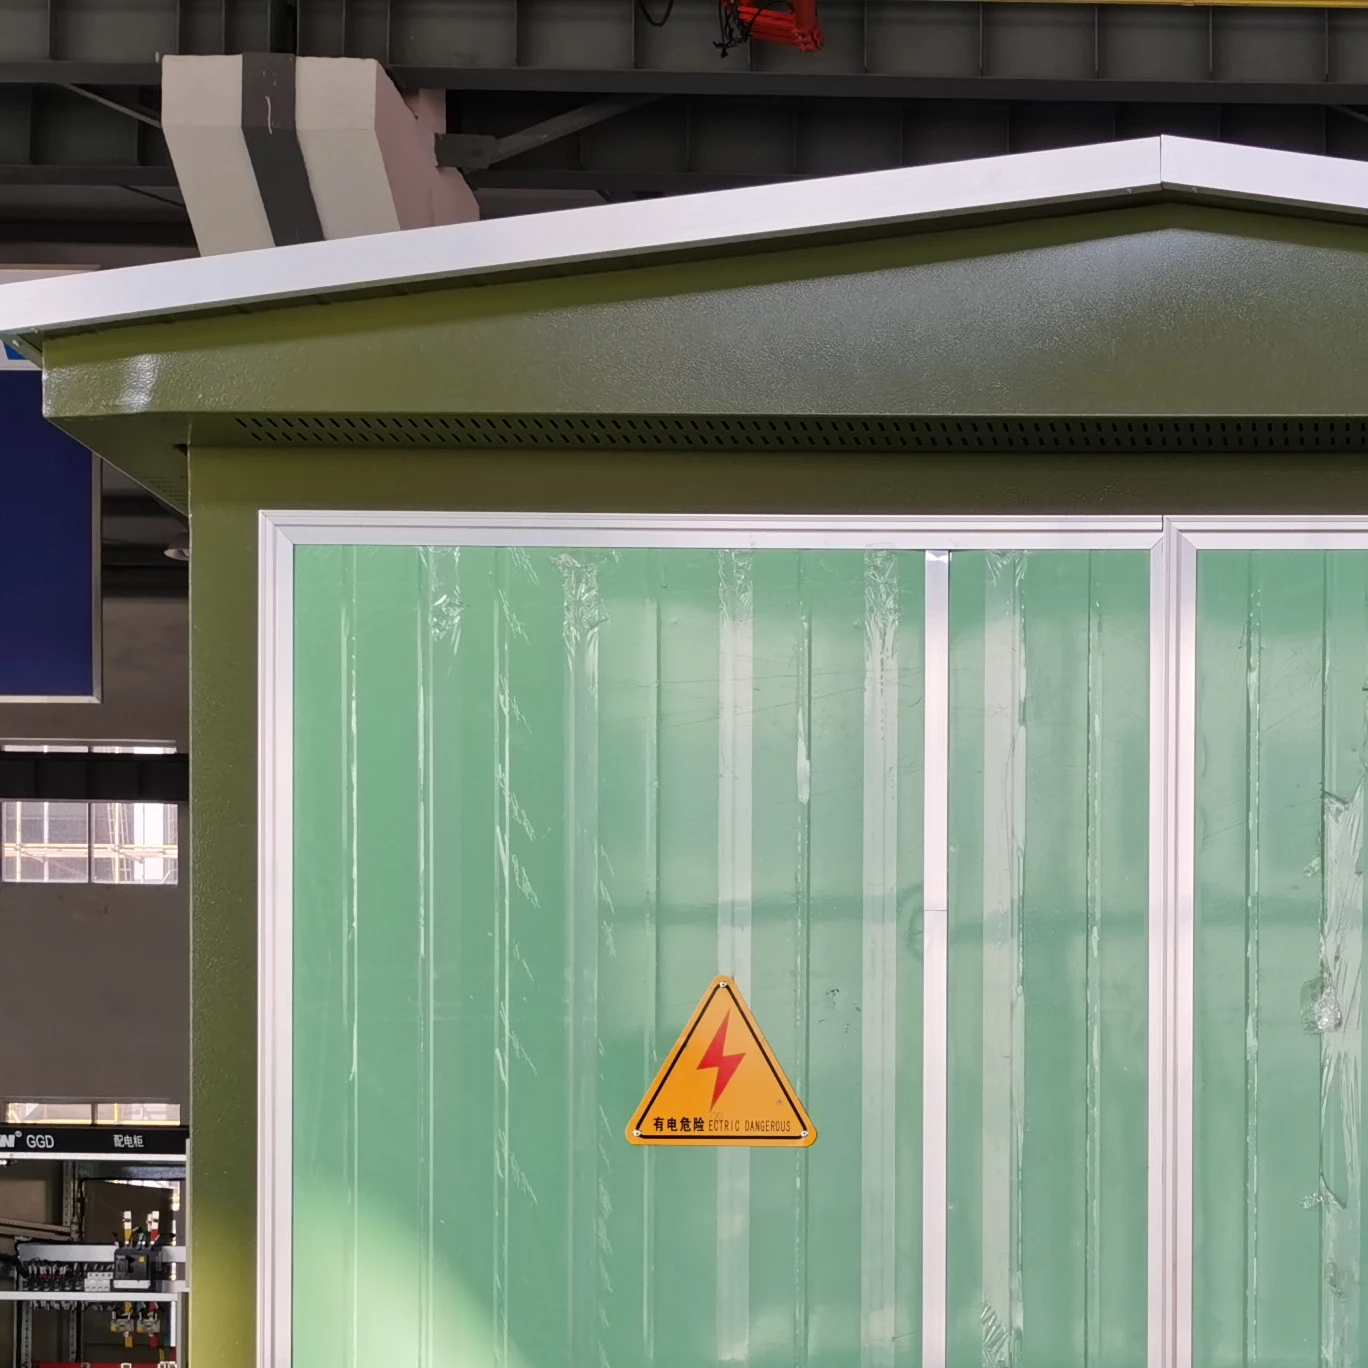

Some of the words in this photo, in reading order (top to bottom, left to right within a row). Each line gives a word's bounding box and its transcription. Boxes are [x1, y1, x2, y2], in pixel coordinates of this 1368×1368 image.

[653, 1116, 705, 1132] 有电危险
[708, 1120, 740, 1132] ECTRIC
[744, 1120, 791, 1132] DANGEROUS
[26, 1134, 55, 1148] GGD
[113, 1134, 144, 1148] 配电柜
